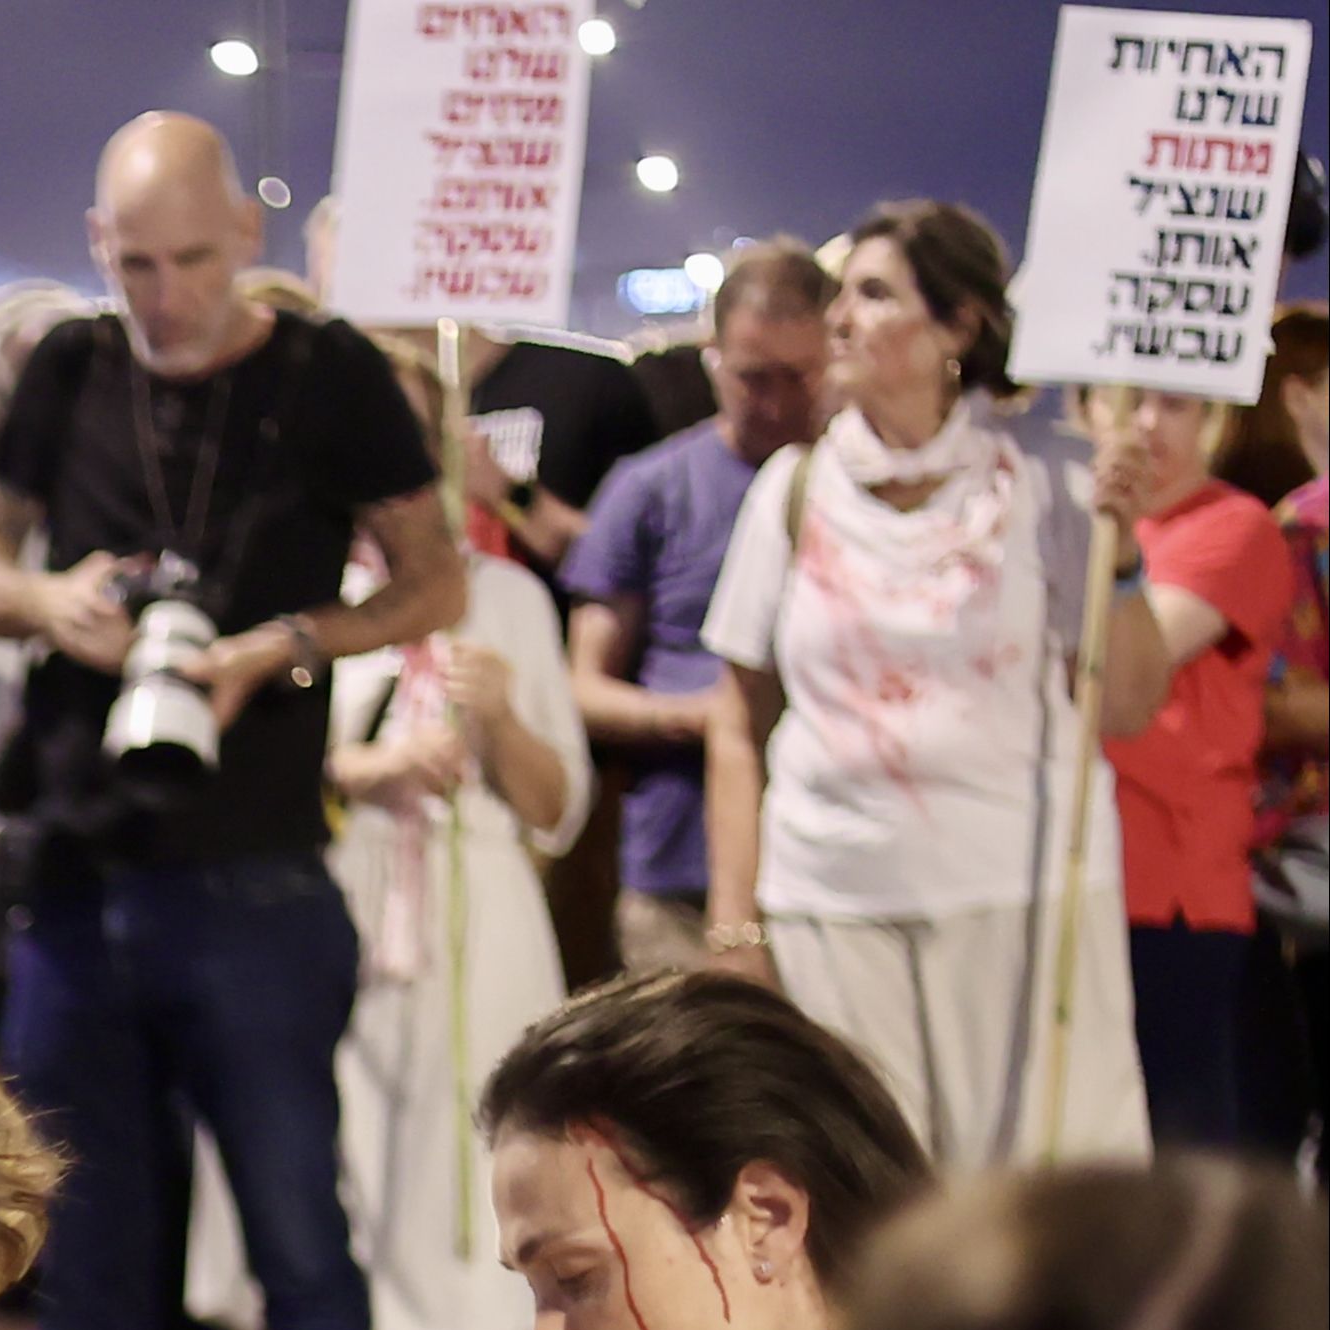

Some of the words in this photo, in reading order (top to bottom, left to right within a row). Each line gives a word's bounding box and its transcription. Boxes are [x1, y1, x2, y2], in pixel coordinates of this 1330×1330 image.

[416, 4, 570, 42] האחים
[464, 48, 566, 83] שלנו
[1110, 36, 1285, 79] האחיות
[443, 90, 565, 126] מתים
[1175, 86, 1278, 126] שלנו
[1144, 131, 1273, 175] מתות
[1128, 176, 1266, 219] שנציל
[1107, 271, 1251, 317] עסקה
